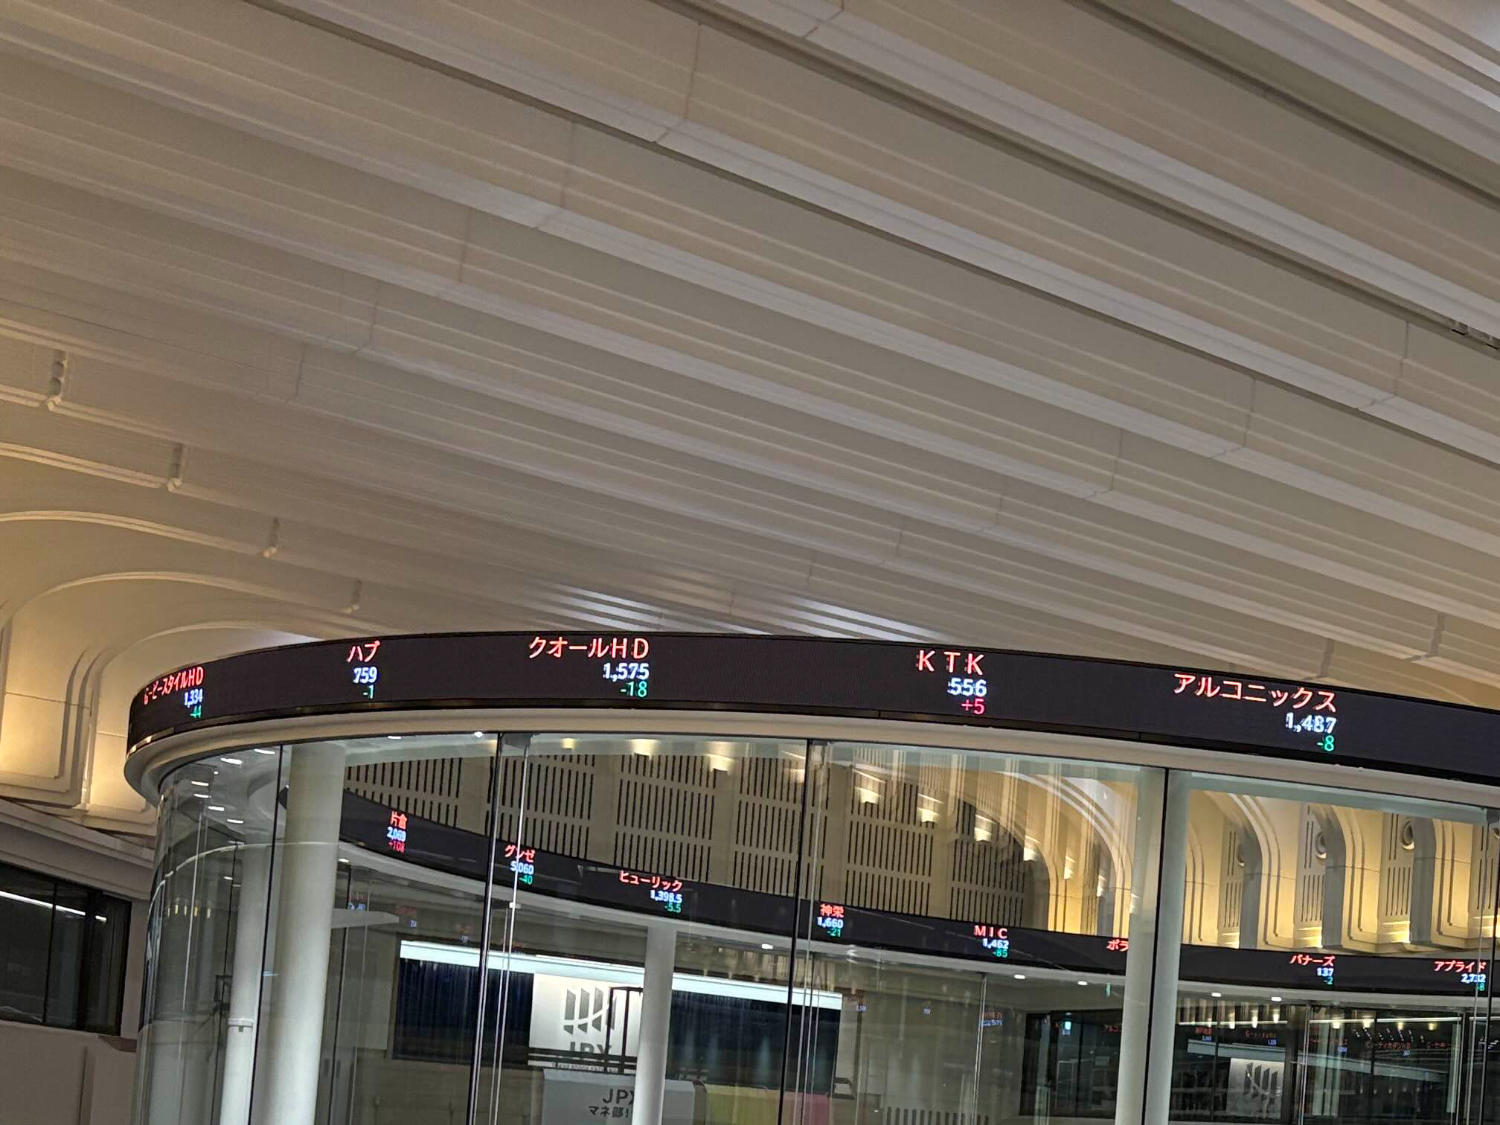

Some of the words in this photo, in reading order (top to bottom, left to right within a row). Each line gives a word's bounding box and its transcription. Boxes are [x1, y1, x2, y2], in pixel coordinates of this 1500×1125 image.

[346, 640, 380, 664] ハブ
[528, 636, 649, 662] クオールHD
[353, 667, 378, 684] 759
[602, 663, 649, 681] 1,575
[619, 681, 648, 698] -18
[949, 678, 987, 697] 556
[1173, 673, 1337, 712] アルコニックス
[961, 698, 985, 715] +5
[1285, 711, 1337, 734] 1,487
[1317, 735, 1334, 752] -8
[504, 844, 536, 864] グンゼ
[620, 870, 683, 892] ヒューリック
[974, 925, 1008, 939] MIC
[1434, 960, 1487, 973] アプライド
